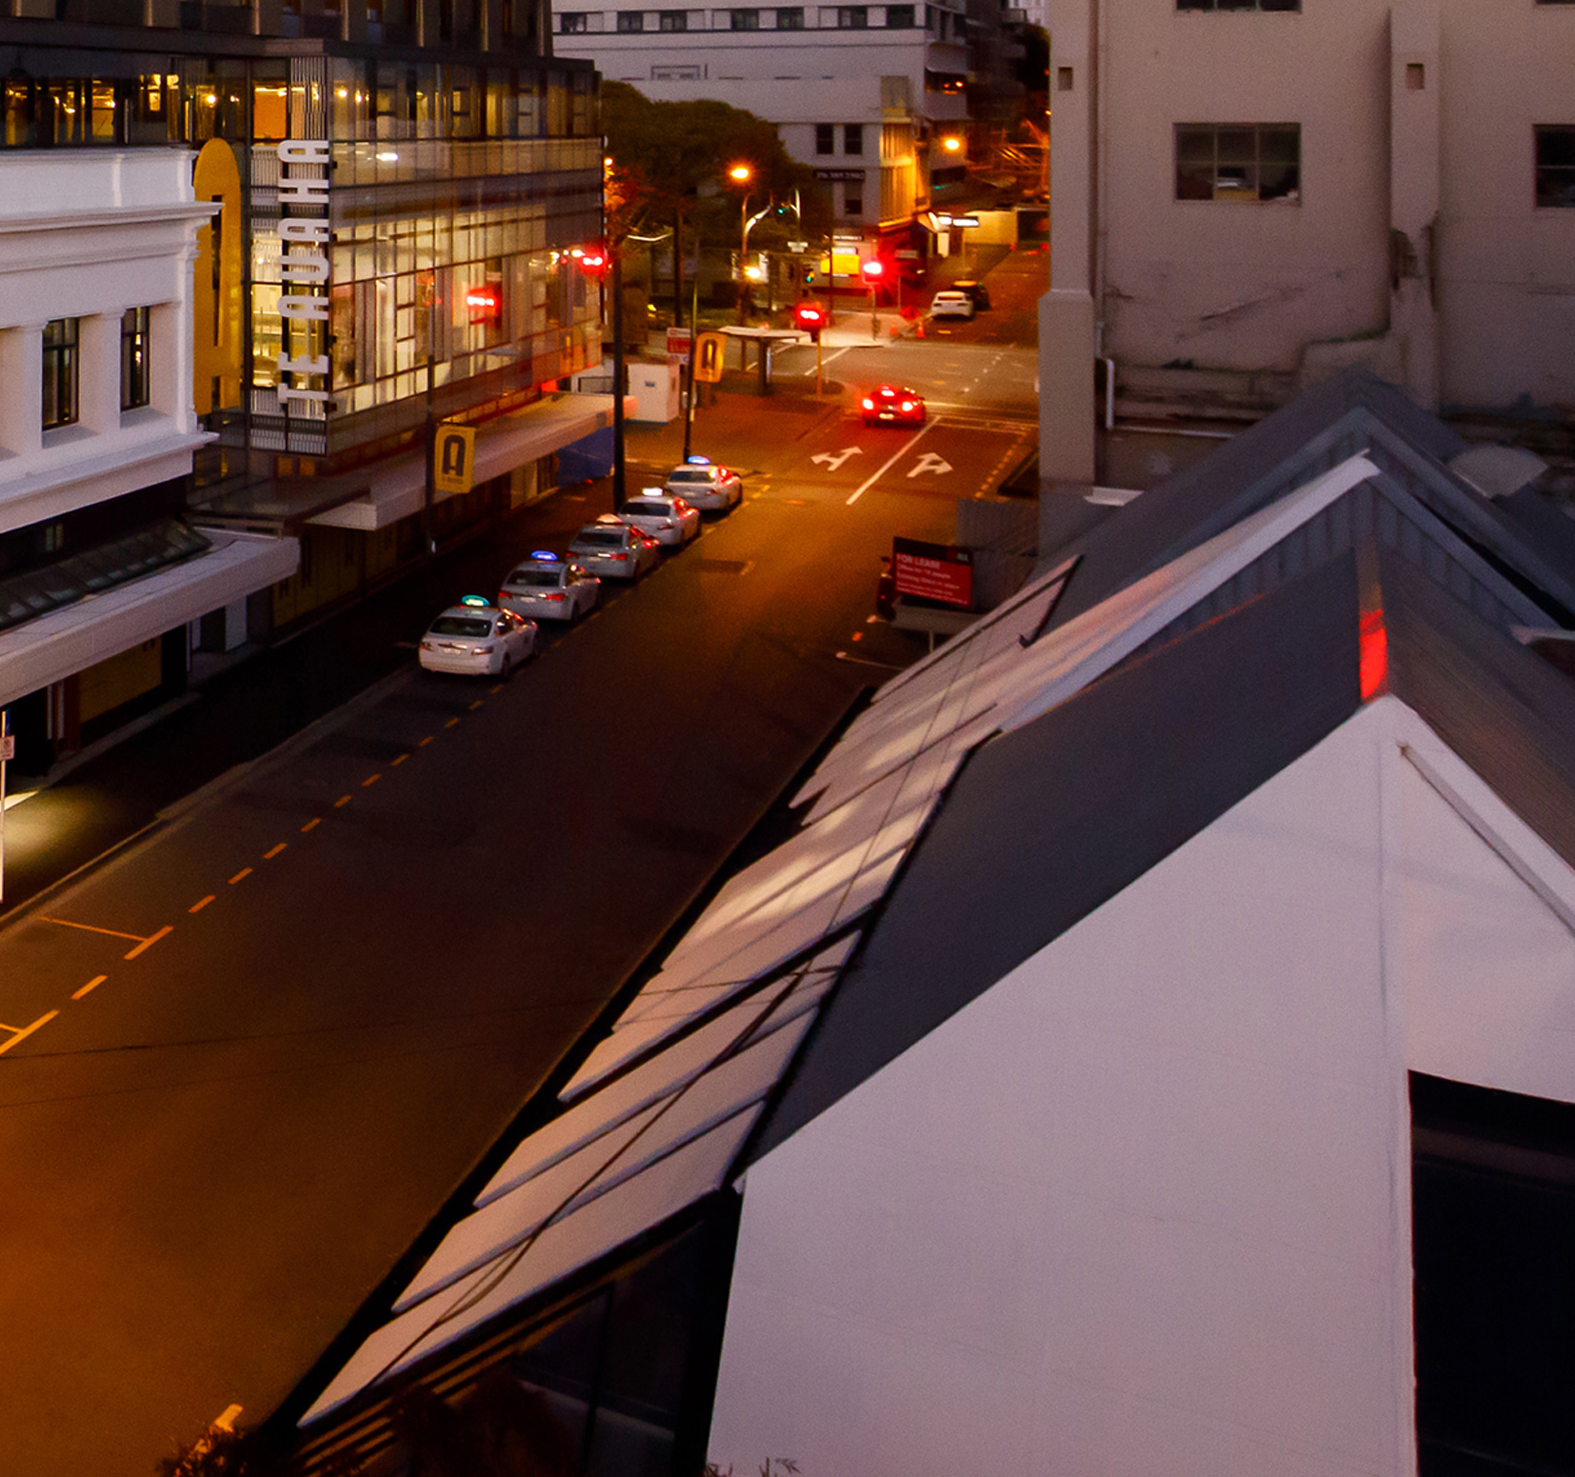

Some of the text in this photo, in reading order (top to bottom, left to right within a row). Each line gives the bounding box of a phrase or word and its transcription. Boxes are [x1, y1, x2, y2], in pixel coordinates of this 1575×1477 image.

[278, 140, 329, 404] TE AUAHA
[896, 553, 913, 563] FOR
